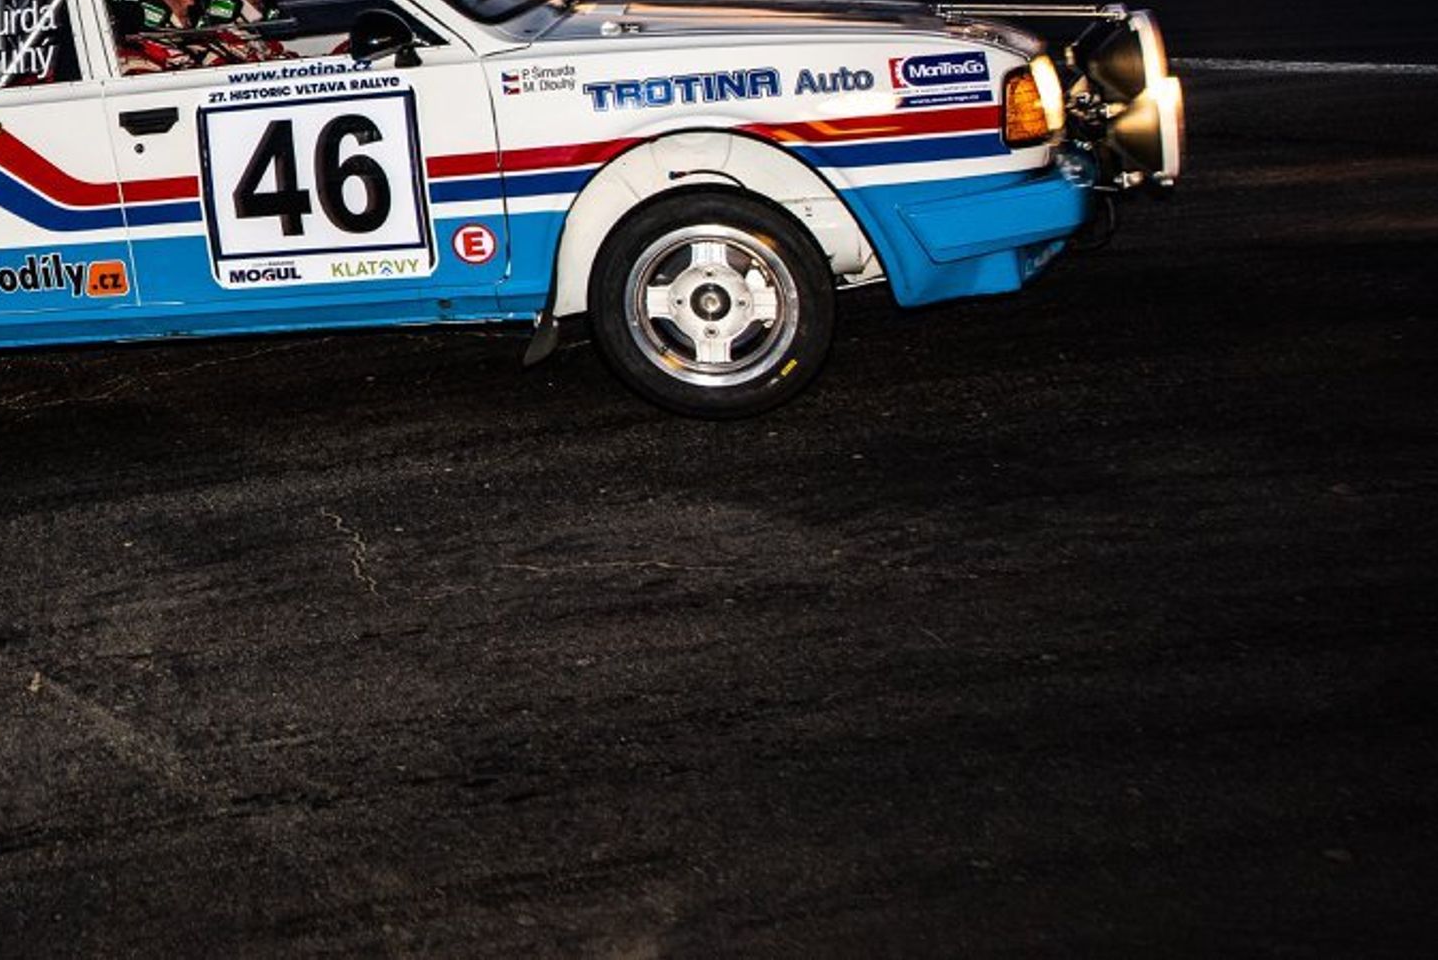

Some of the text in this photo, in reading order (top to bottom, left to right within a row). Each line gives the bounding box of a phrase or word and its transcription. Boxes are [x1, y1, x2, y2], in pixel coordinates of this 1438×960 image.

[228, 60, 373, 84] www.trotina.cz
[230, 85, 291, 101] HISTORIC
[295, 80, 345, 96] VLTAVA
[583, 66, 875, 112] TROTINA Auto
[231, 113, 392, 238] 46
[461, 230, 485, 257] E
[229, 258, 420, 283] MOGUL KLATOVY
